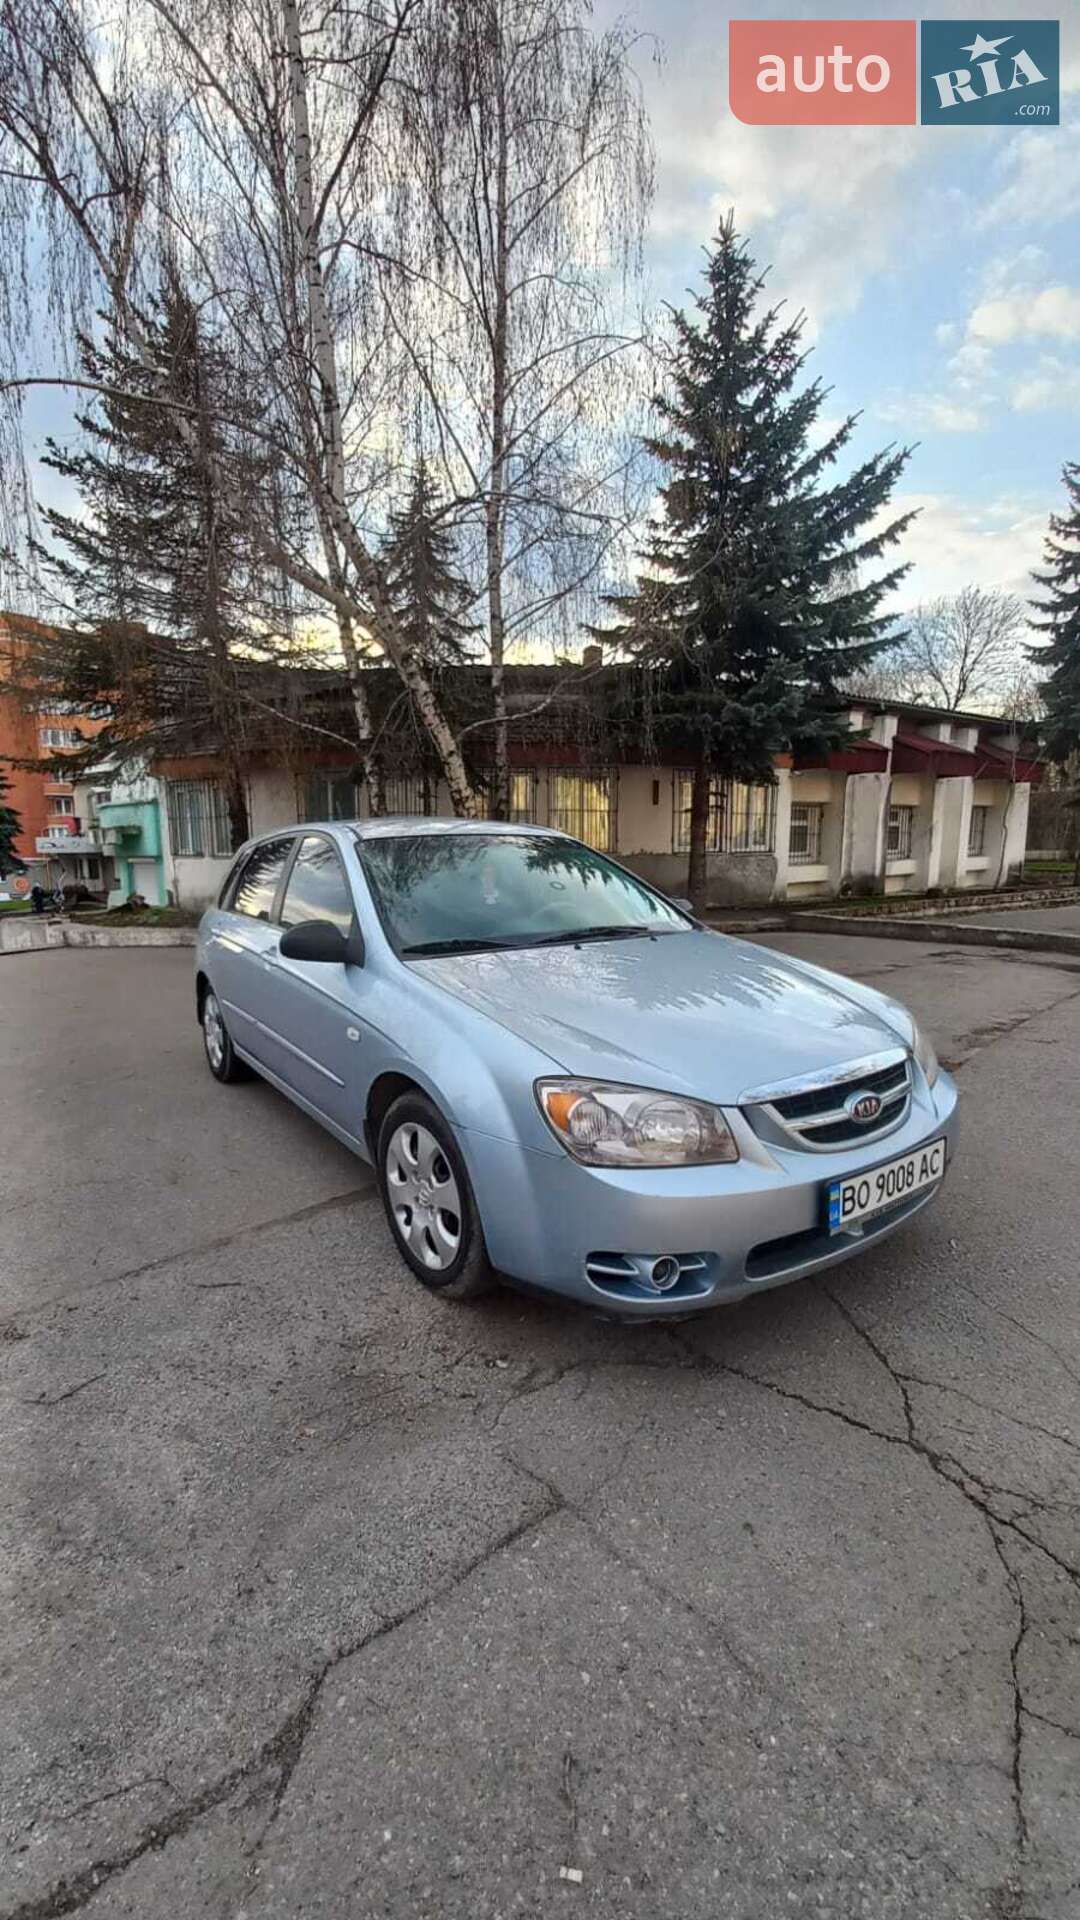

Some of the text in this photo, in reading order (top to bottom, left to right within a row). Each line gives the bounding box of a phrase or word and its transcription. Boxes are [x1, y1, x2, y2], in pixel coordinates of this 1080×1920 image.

[855, 1098, 879, 1118] KIA
[841, 1180, 870, 1216] BO
[875, 1161, 914, 1203] 9008
[918, 1149, 940, 1182] AC
